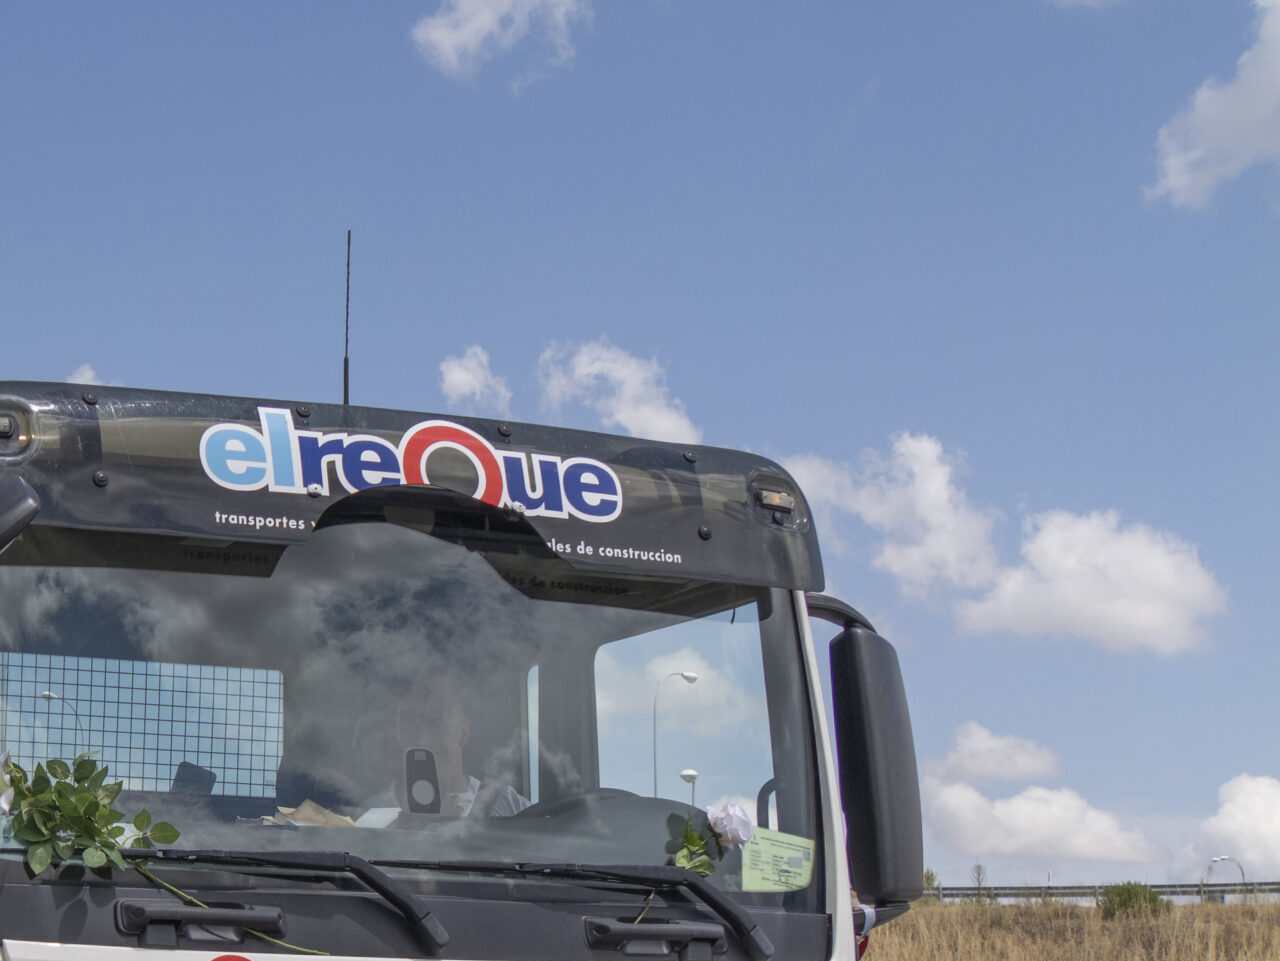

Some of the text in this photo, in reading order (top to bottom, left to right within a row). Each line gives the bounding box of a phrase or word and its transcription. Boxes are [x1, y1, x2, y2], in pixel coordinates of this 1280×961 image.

[214, 511, 305, 530] transportes
[576, 541, 594, 556] de
[598, 546, 682, 564] construccion
